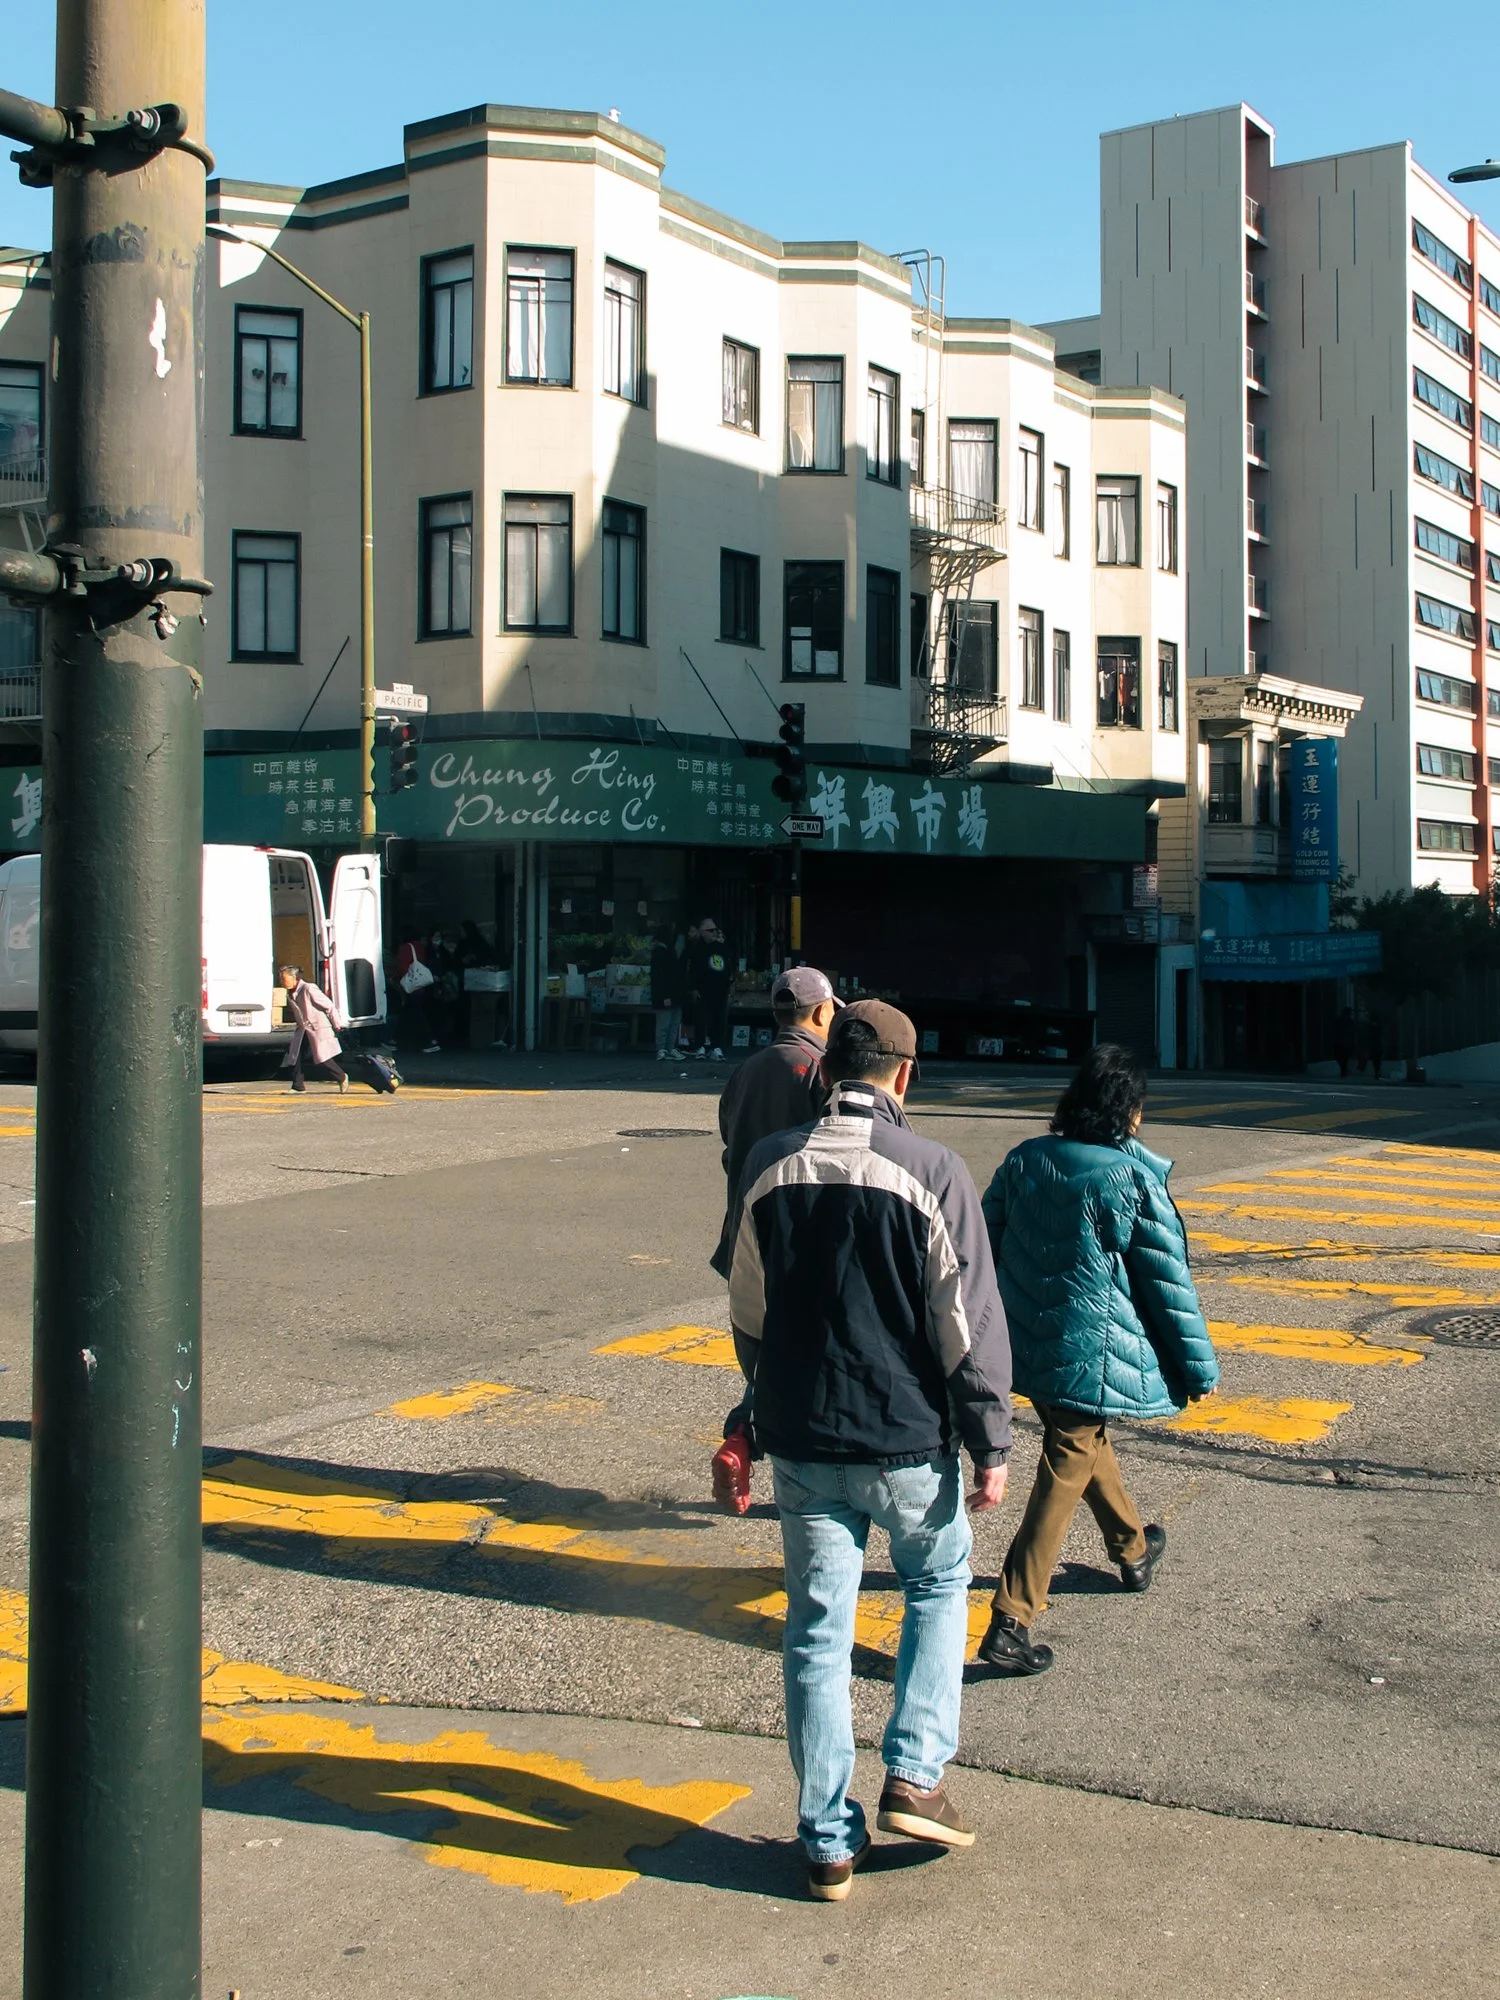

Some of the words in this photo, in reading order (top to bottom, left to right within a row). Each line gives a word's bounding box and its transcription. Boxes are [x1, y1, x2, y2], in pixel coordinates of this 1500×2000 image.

[384, 695, 423, 708] PACIFIC
[430, 752, 556, 796] Chung
[572, 748, 657, 800] Hing
[446, 793, 613, 837] Produce
[621, 797, 667, 832] Co.
[810, 770, 988, 851] 祥興市場
[792, 821, 804, 831] ONE
[806, 822, 820, 832] WAY
[1203, 955, 1221, 963] GOLD
[1239, 956, 1266, 964] TRADING
